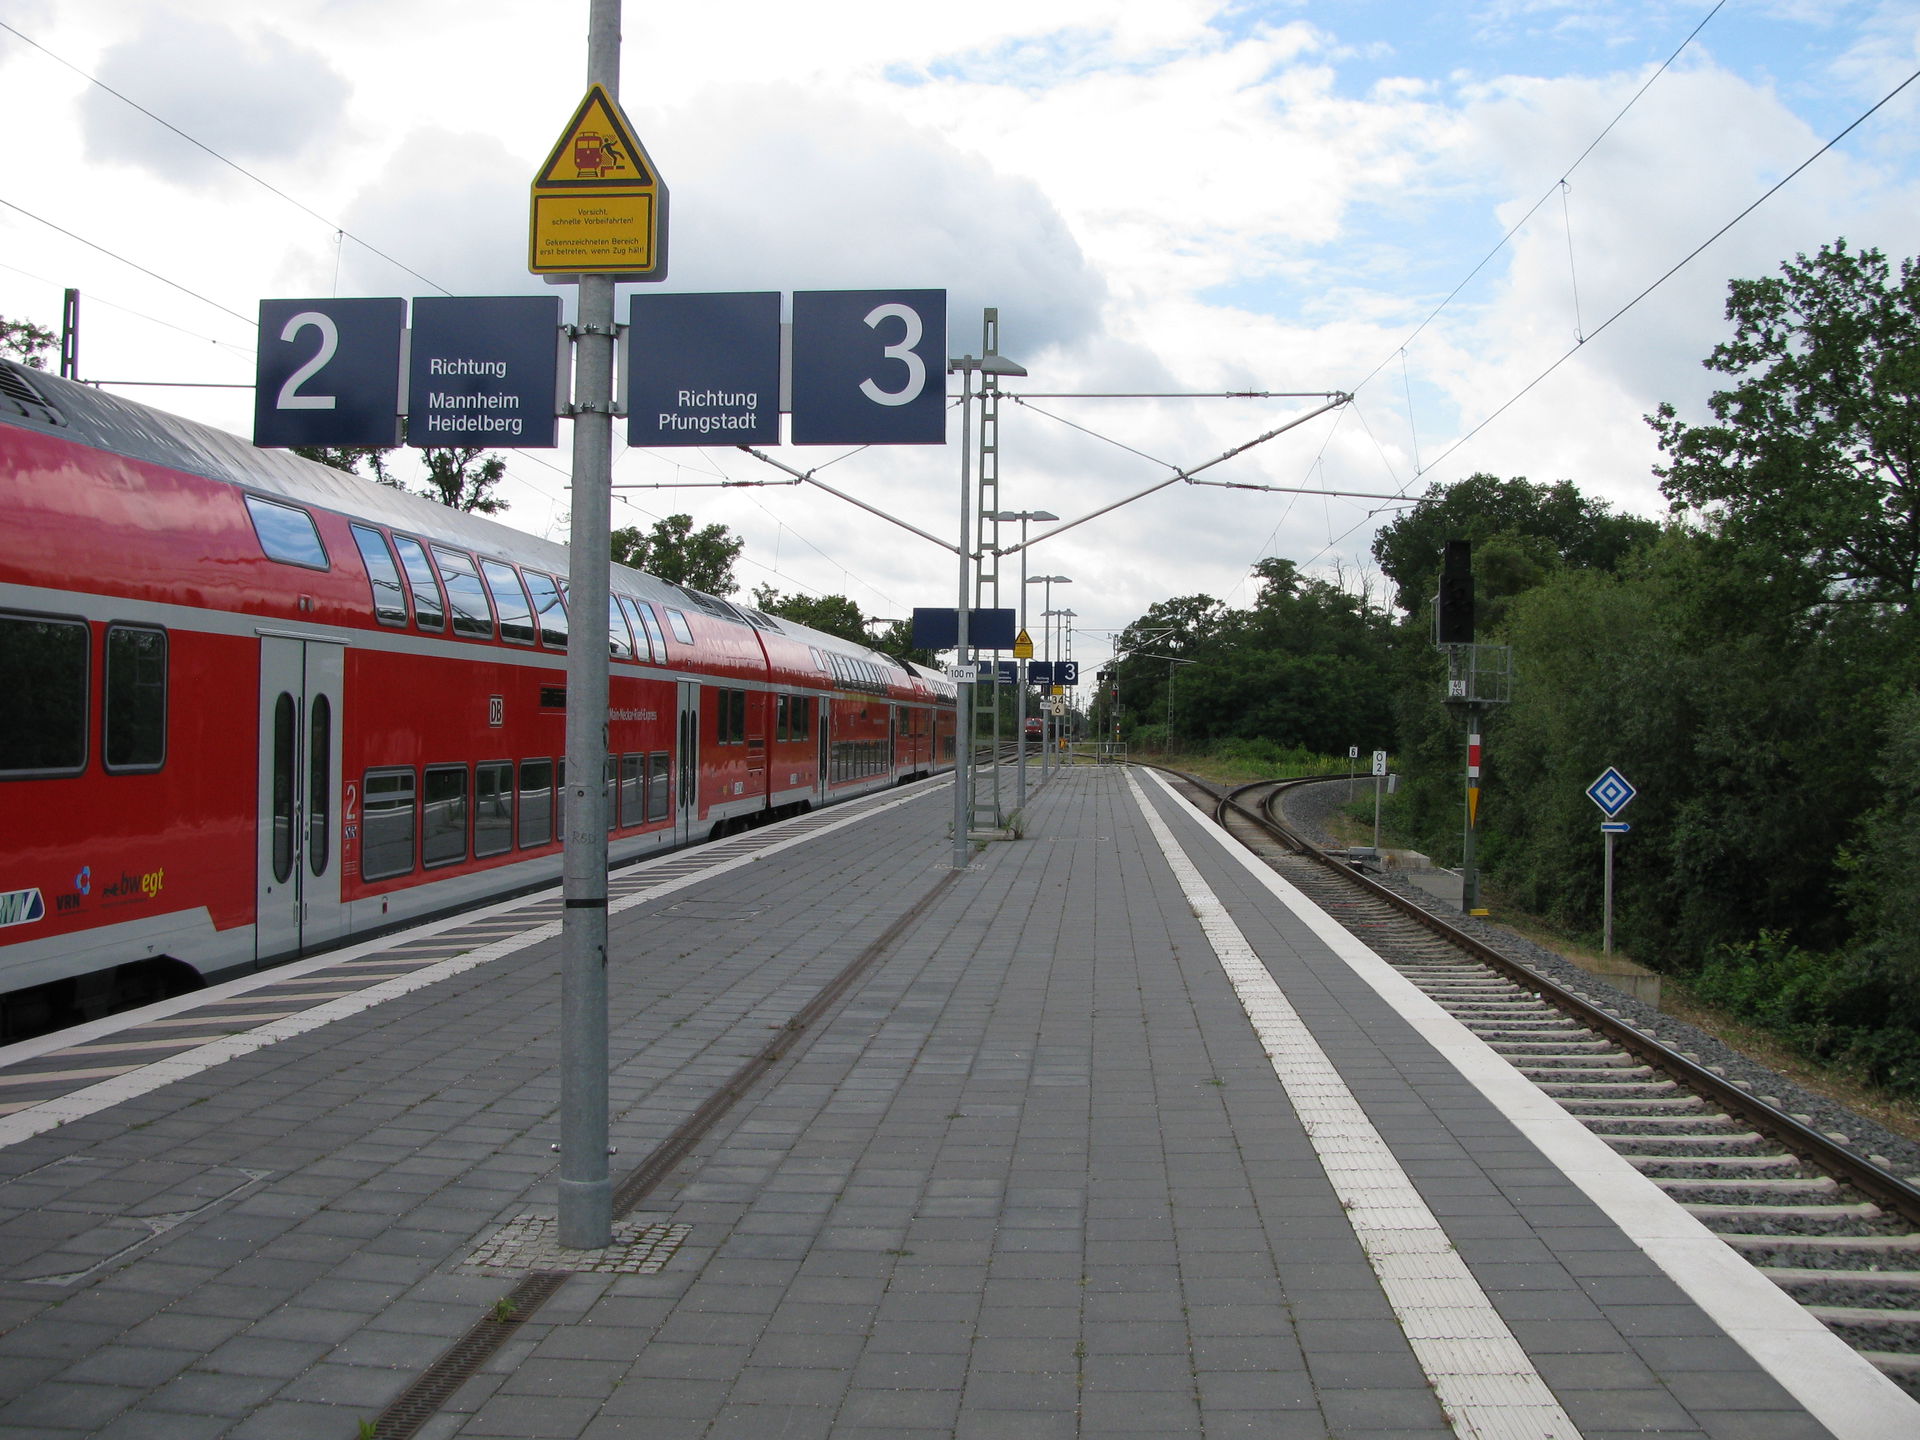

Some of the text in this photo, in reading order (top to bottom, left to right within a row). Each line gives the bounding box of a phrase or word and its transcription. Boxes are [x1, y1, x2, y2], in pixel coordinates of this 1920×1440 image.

[552, 217, 634, 226] schnelle Vorbeifahrten!
[545, 237, 639, 246] Gekennzeichneten Bereich
[613, 247, 626, 256] Zug
[275, 311, 339, 411] 2
[859, 303, 927, 407] 3
[430, 357, 508, 379] Richtung
[429, 392, 520, 410] Mannheim
[677, 389, 758, 411] Richtung
[428, 415, 523, 436] Heidelberg
[658, 413, 757, 433] Pfungstadt
[950, 669, 965, 679] 100
[1065, 663, 1076, 680] 3
[1052, 696, 1063, 705] 34
[1055, 705, 1061, 713] 6
[491, 701, 502, 723] DB
[1351, 748, 1356, 757] 6
[1377, 763, 1382, 772] 2
[346, 784, 356, 820] 2
[121, 867, 164, 898] bwegt
[0, 889, 37, 925] MV
[56, 893, 80, 911] VRN
